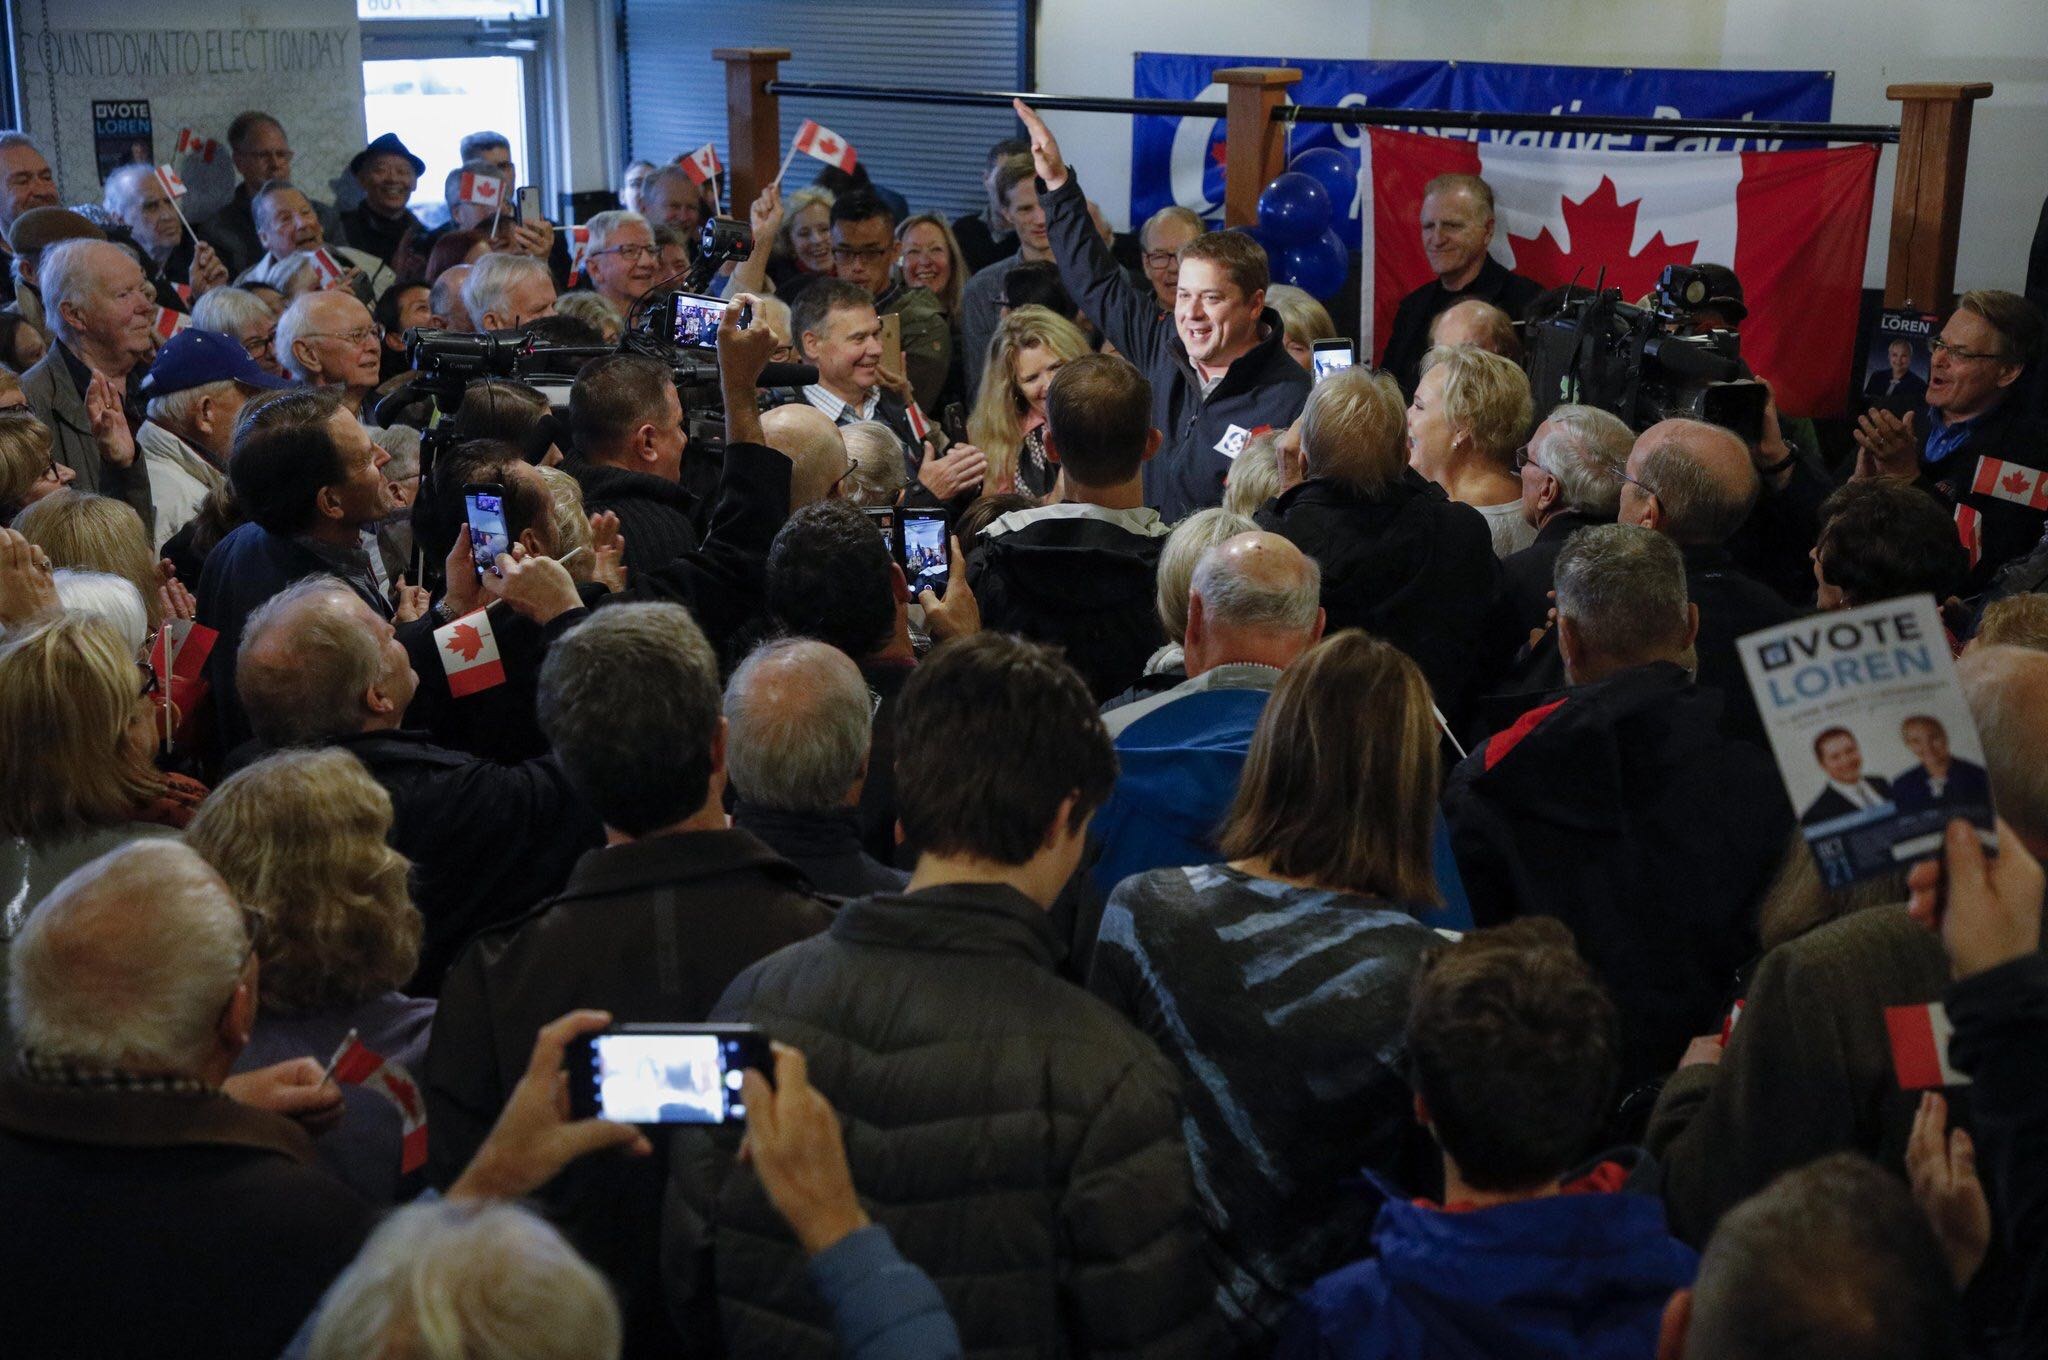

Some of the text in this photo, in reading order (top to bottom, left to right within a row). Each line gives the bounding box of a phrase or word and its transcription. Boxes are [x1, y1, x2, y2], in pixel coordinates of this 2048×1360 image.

[205, 29, 304, 75] ELECTION
[309, 29, 350, 73] DAY
[97, 119, 152, 134] LOREN
[107, 104, 149, 119] VOTE
[1332, 93, 1632, 153] Cervative
[1881, 317, 1930, 333] LOREN
[1793, 611, 1923, 659] VOTE
[1767, 647, 1935, 707] LOREN
